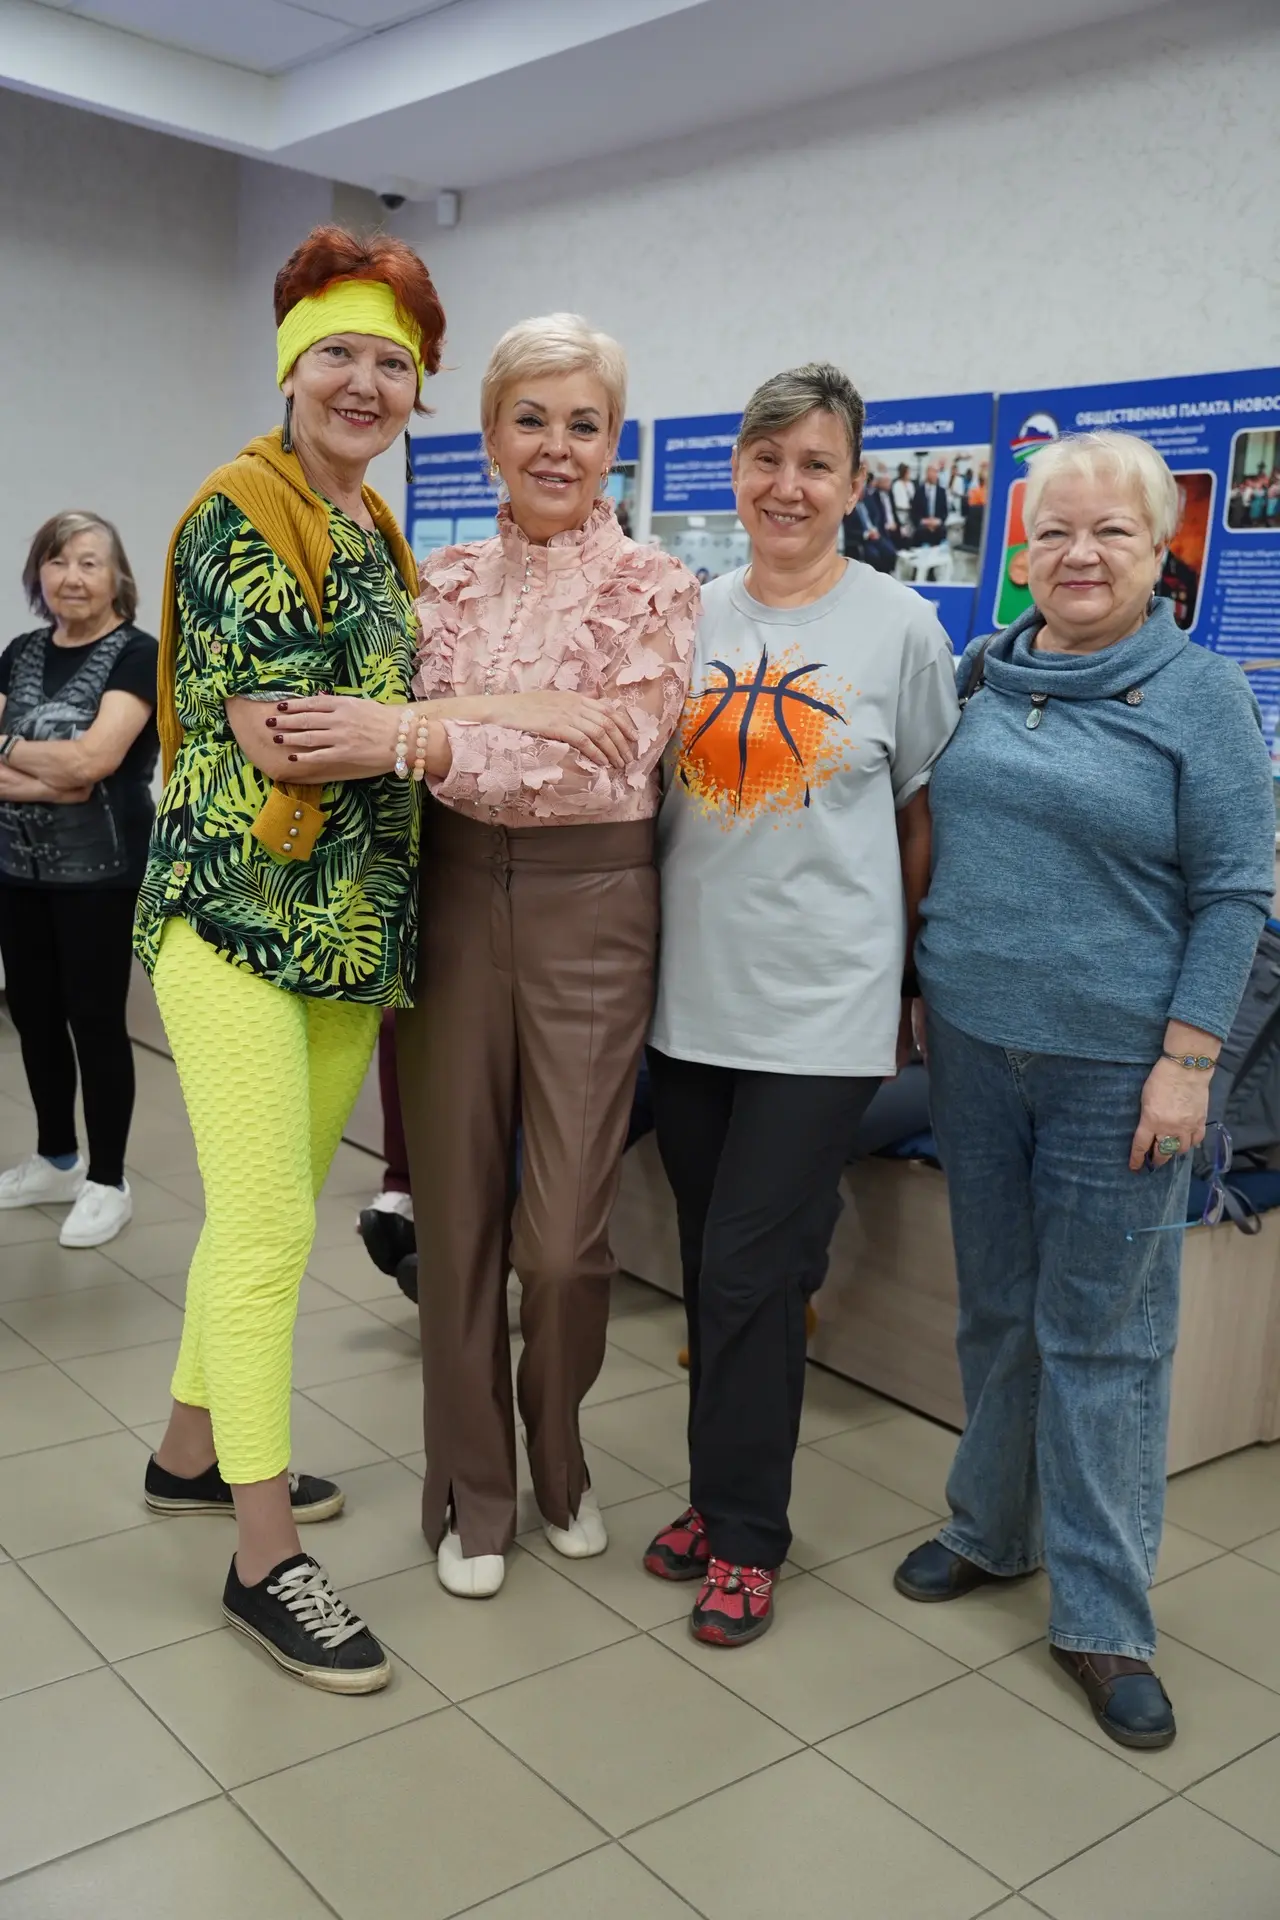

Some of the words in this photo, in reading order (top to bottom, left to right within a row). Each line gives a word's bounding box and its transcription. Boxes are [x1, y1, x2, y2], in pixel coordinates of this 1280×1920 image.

[1076, 404, 1177, 426] ОБЩЕСТВЕННАЯ
[1179, 400, 1231, 418] ПАЛАТА
[862, 420, 903, 438] ИРСКОЙ
[905, 420, 954, 436] ОБЛАСТИ
